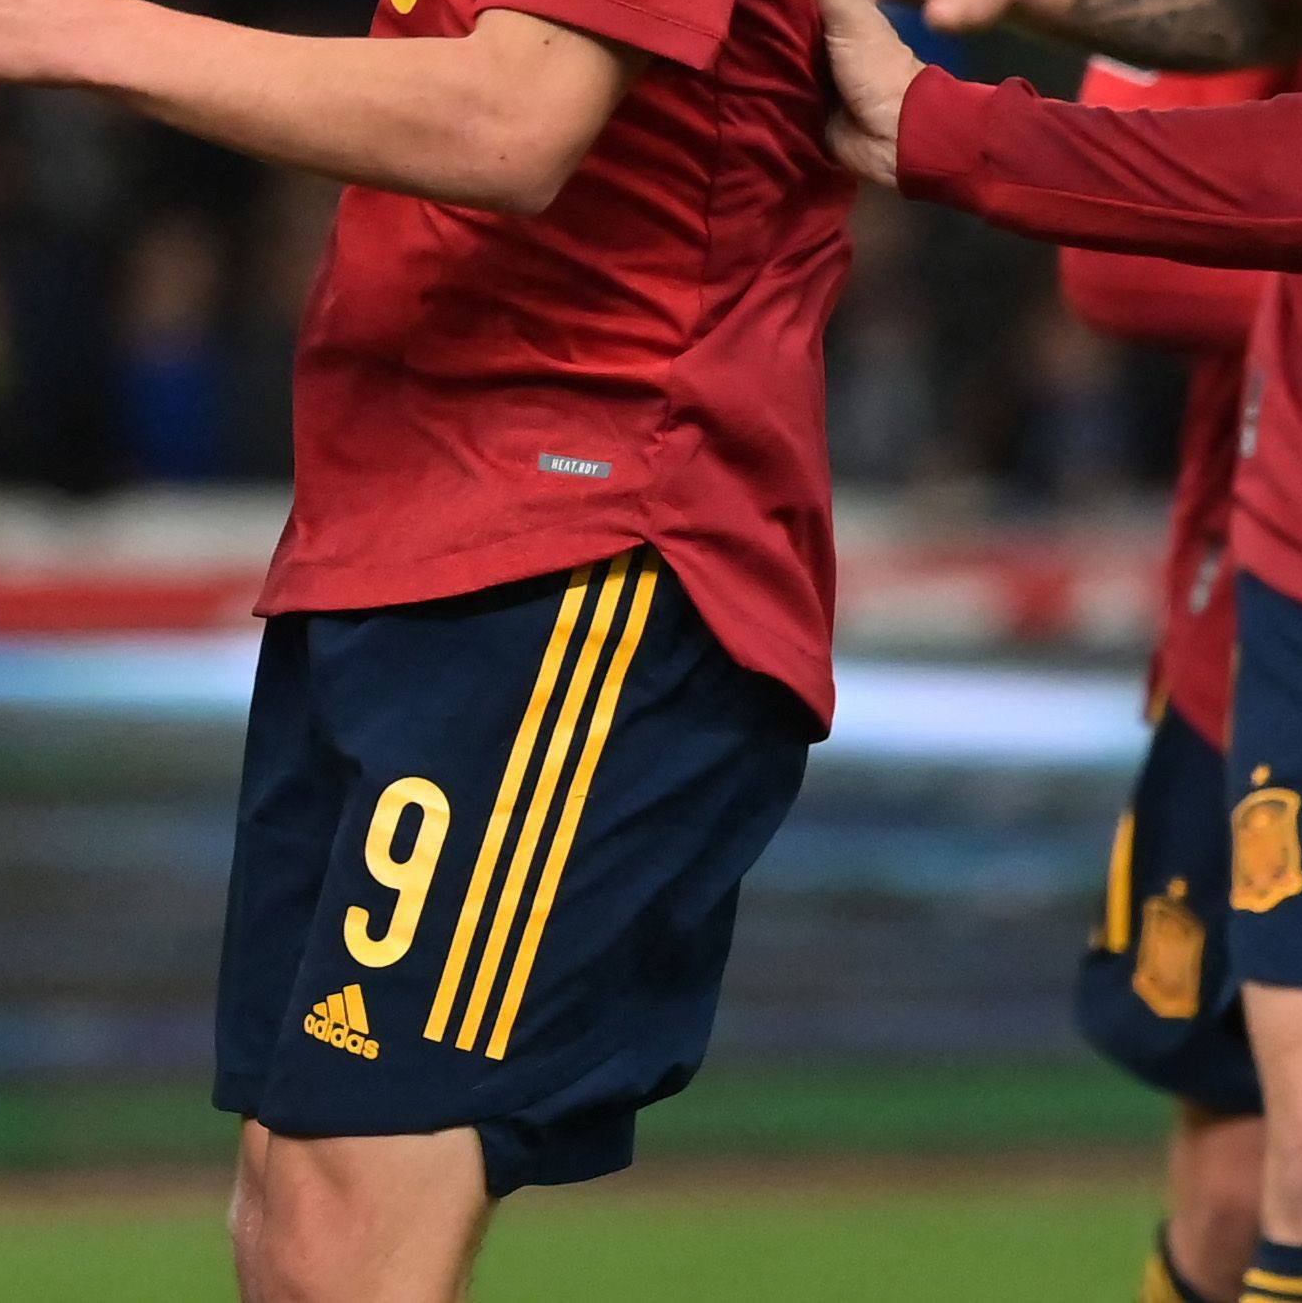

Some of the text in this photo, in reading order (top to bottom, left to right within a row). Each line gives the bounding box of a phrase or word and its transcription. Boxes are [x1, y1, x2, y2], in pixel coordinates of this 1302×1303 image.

[551, 458, 599, 475] HEAT.RDY
[344, 776, 451, 968] 9
[304, 1014, 380, 1060] adidas
